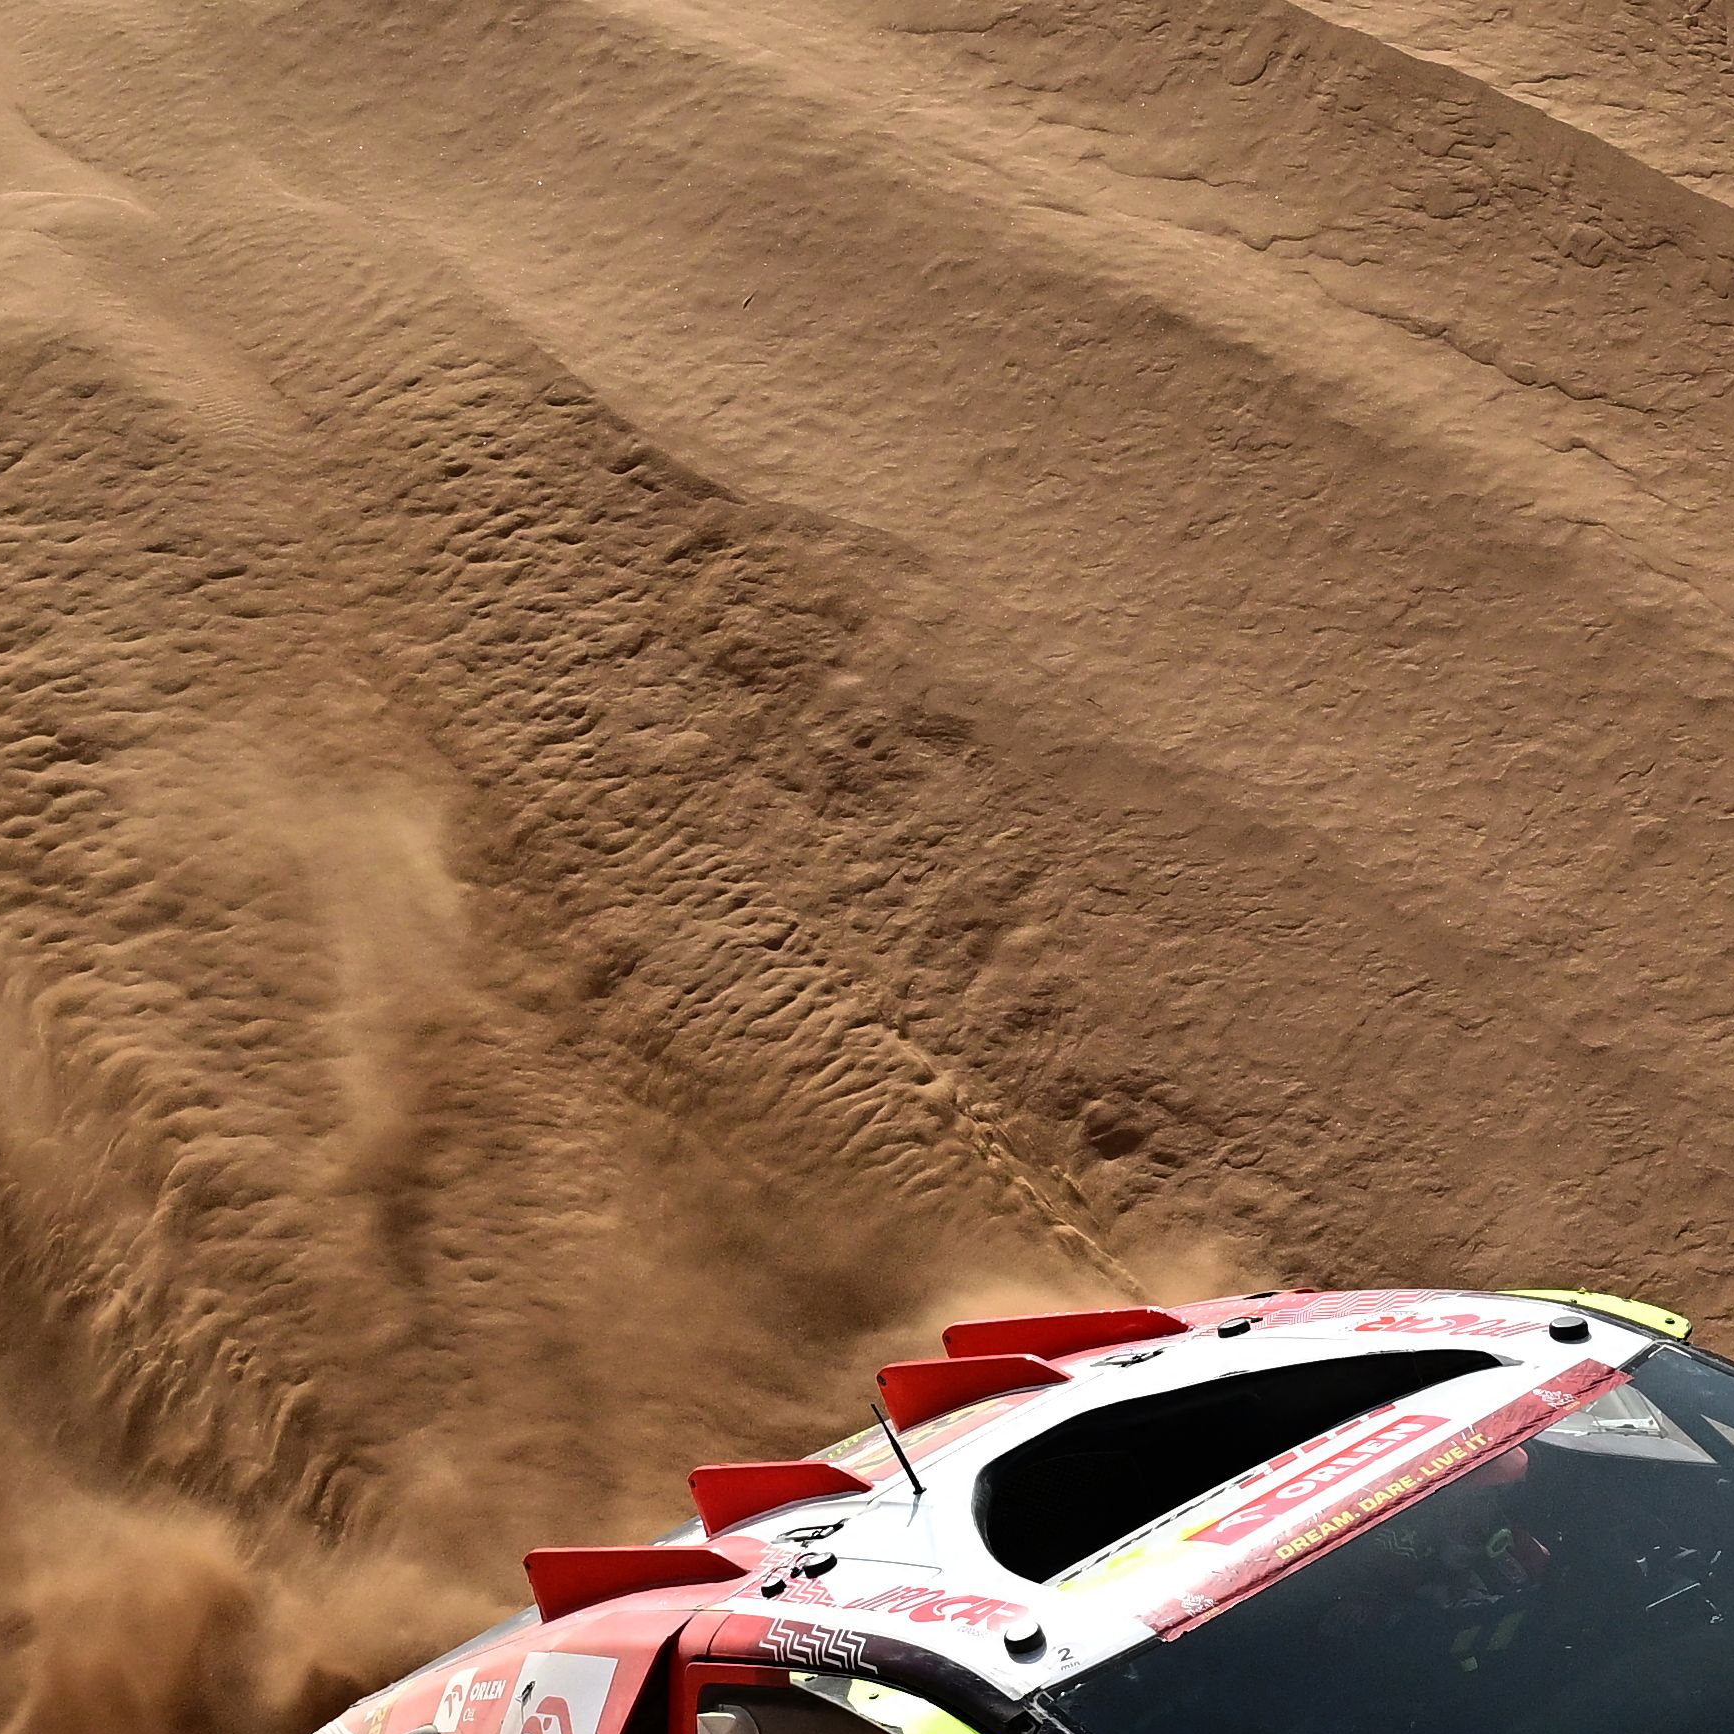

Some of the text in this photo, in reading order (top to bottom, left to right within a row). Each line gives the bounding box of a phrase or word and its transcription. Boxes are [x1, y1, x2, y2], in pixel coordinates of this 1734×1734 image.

[1275, 1422, 1426, 1500] ORLEN
[1275, 1432, 1494, 1560] DREAM. DARE. LIVE IT.
[1058, 1647, 1074, 1662] 2
[1060, 1661, 1081, 1671] min
[470, 1680, 507, 1702] ORLEN
